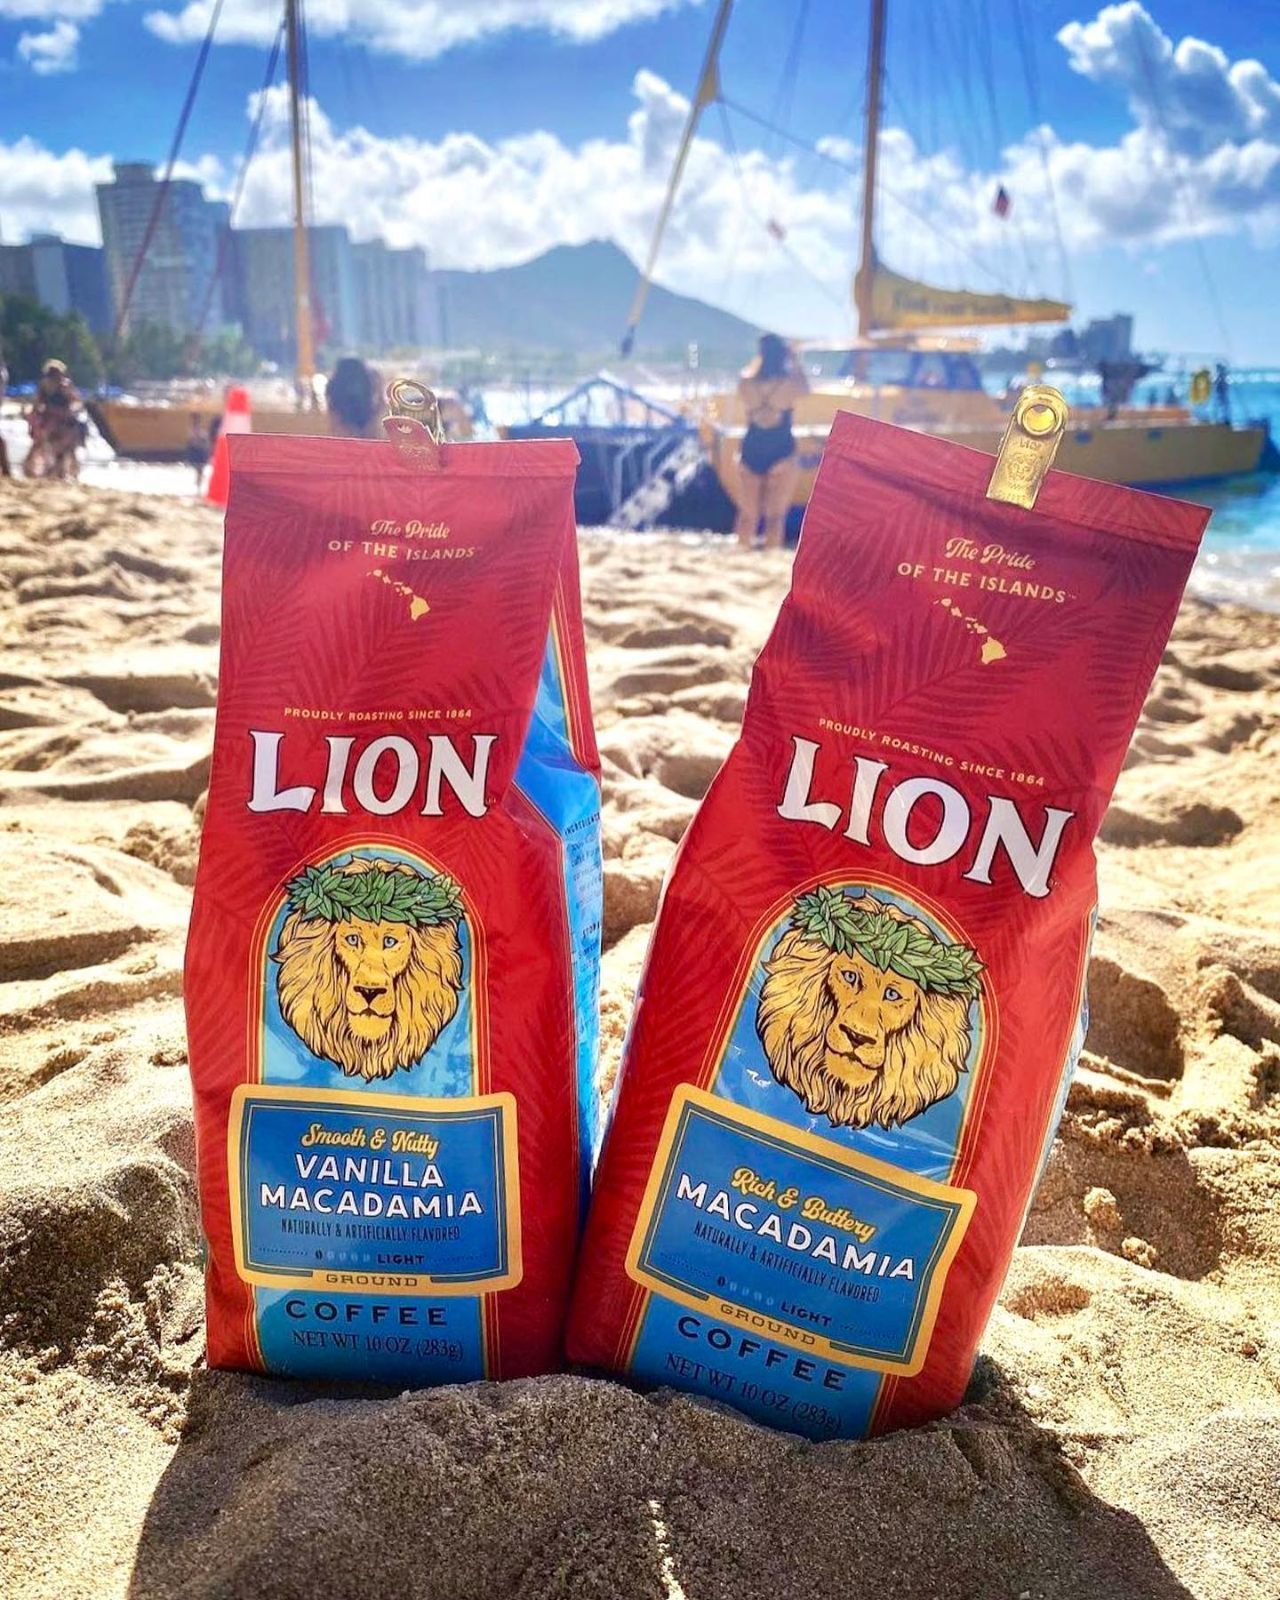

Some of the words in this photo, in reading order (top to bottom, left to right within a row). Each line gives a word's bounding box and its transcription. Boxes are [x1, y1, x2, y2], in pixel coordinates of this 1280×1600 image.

[370, 519, 401, 536] The
[405, 519, 450, 539] Pride
[328, 540, 353, 552] OF
[361, 541, 398, 559] THE
[406, 546, 475, 561] ISLANDS
[944, 537, 979, 561] The
[979, 543, 1036, 570] Pride
[897, 562, 926, 578] OF
[933, 567, 972, 587] THE
[979, 575, 1067, 603] ISLANDS
[284, 707, 344, 721] PROUDLY
[348, 710, 404, 721] ROASTING
[407, 709, 442, 720] SINCE
[446, 708, 473, 719] 1864
[818, 717, 877, 742] PROUDLY
[881, 735, 954, 767] ROASTING
[960, 760, 1004, 779] SINCE
[1010, 770, 1046, 787] 1864
[246, 729, 499, 818] LION
[776, 734, 1076, 899] LION
[301, 1122, 367, 1148] Smooth
[370, 1127, 387, 1149] &
[391, 1129, 439, 1160] Nutty
[294, 1153, 445, 1188] VANILLA
[260, 1182, 484, 1219] MACADAMIA
[731, 1166, 776, 1202] Rich
[777, 1187, 799, 1209] &
[801, 1196, 877, 1243] Buttery
[281, 1218, 331, 1237] NATURALLY
[335, 1224, 342, 1237] &
[345, 1224, 407, 1241] ARTIFICIALLY
[411, 1226, 460, 1242] FLAVORED
[676, 1173, 916, 1281] MACADAMIA
[377, 1254, 425, 1265] LIGHT
[694, 1219, 748, 1255] NATURALLY
[749, 1245, 758, 1262] &
[760, 1250, 827, 1288] ARTIFICIALLY
[828, 1276, 880, 1303] FLAVORED
[326, 1273, 418, 1287] GROUND
[285, 1299, 448, 1326] COFFEE
[719, 1303, 816, 1345] GROUND
[780, 1300, 832, 1328] LIGHT
[292, 1330, 329, 1348] NET
[331, 1333, 360, 1350] WT
[365, 1334, 382, 1351] 10
[385, 1336, 412, 1354] OZ
[415, 1338, 463, 1362] (283g)
[678, 1316, 847, 1391] COFFEE
[665, 1353, 706, 1380] NET
[708, 1363, 738, 1390] WT
[741, 1380, 758, 1400] 10
[761, 1388, 790, 1411] OZ
[791, 1401, 844, 1436] (283g)
